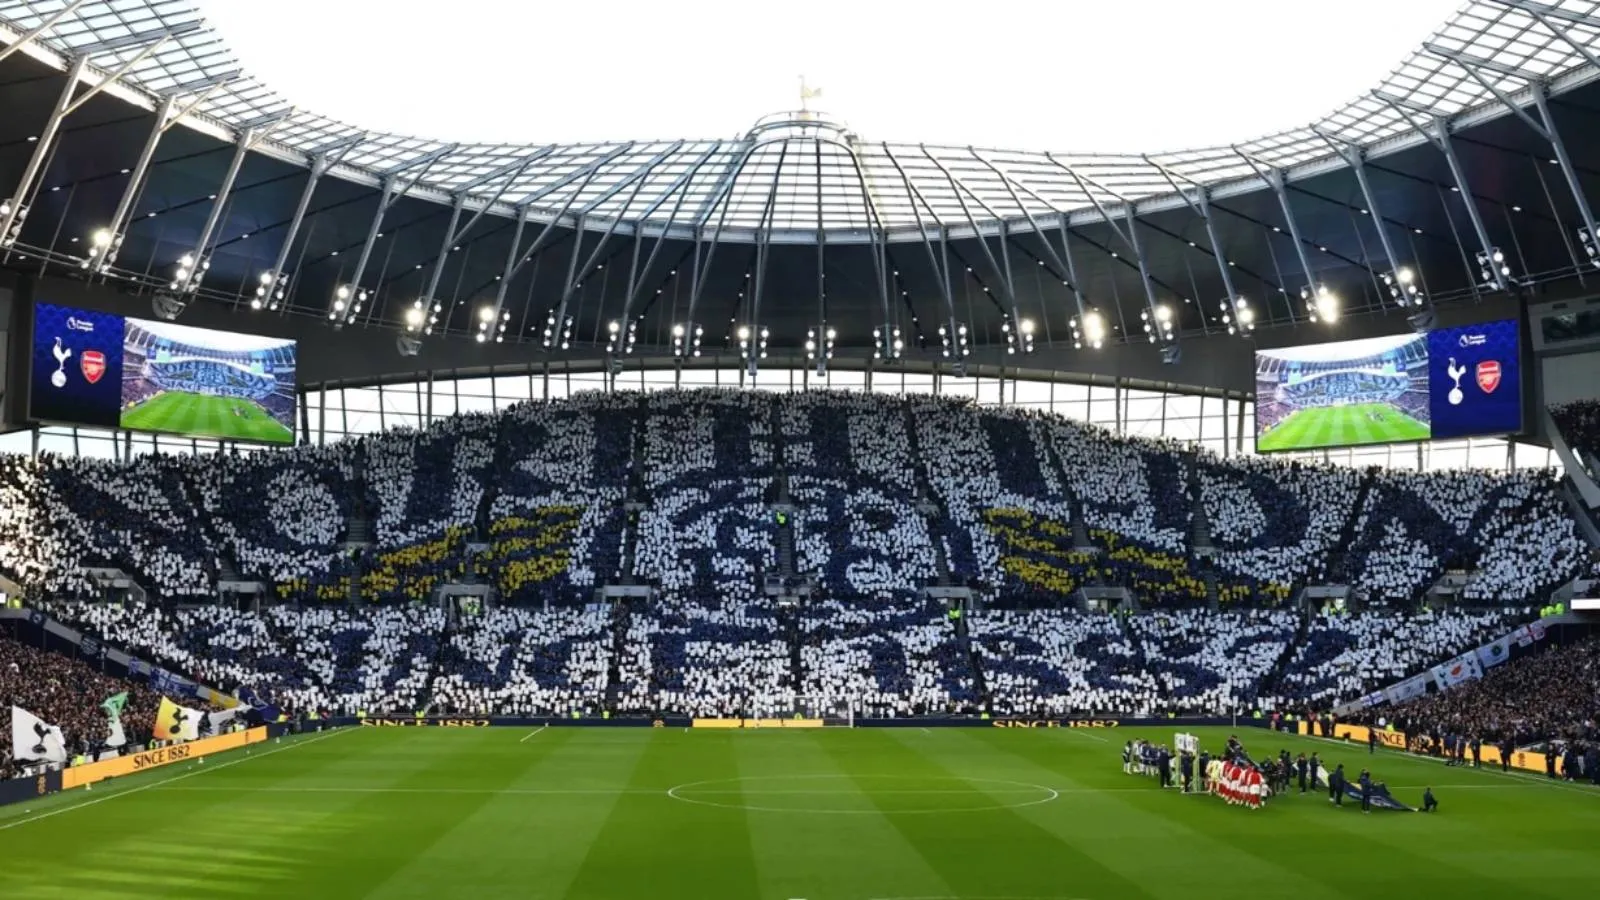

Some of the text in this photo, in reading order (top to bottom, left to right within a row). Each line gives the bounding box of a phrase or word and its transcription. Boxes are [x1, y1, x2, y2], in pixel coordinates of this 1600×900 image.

[360, 719, 490, 728] SINCE 1882
[992, 719, 1119, 728] SINCE 1882
[133, 745, 190, 769] SINCE 1882
